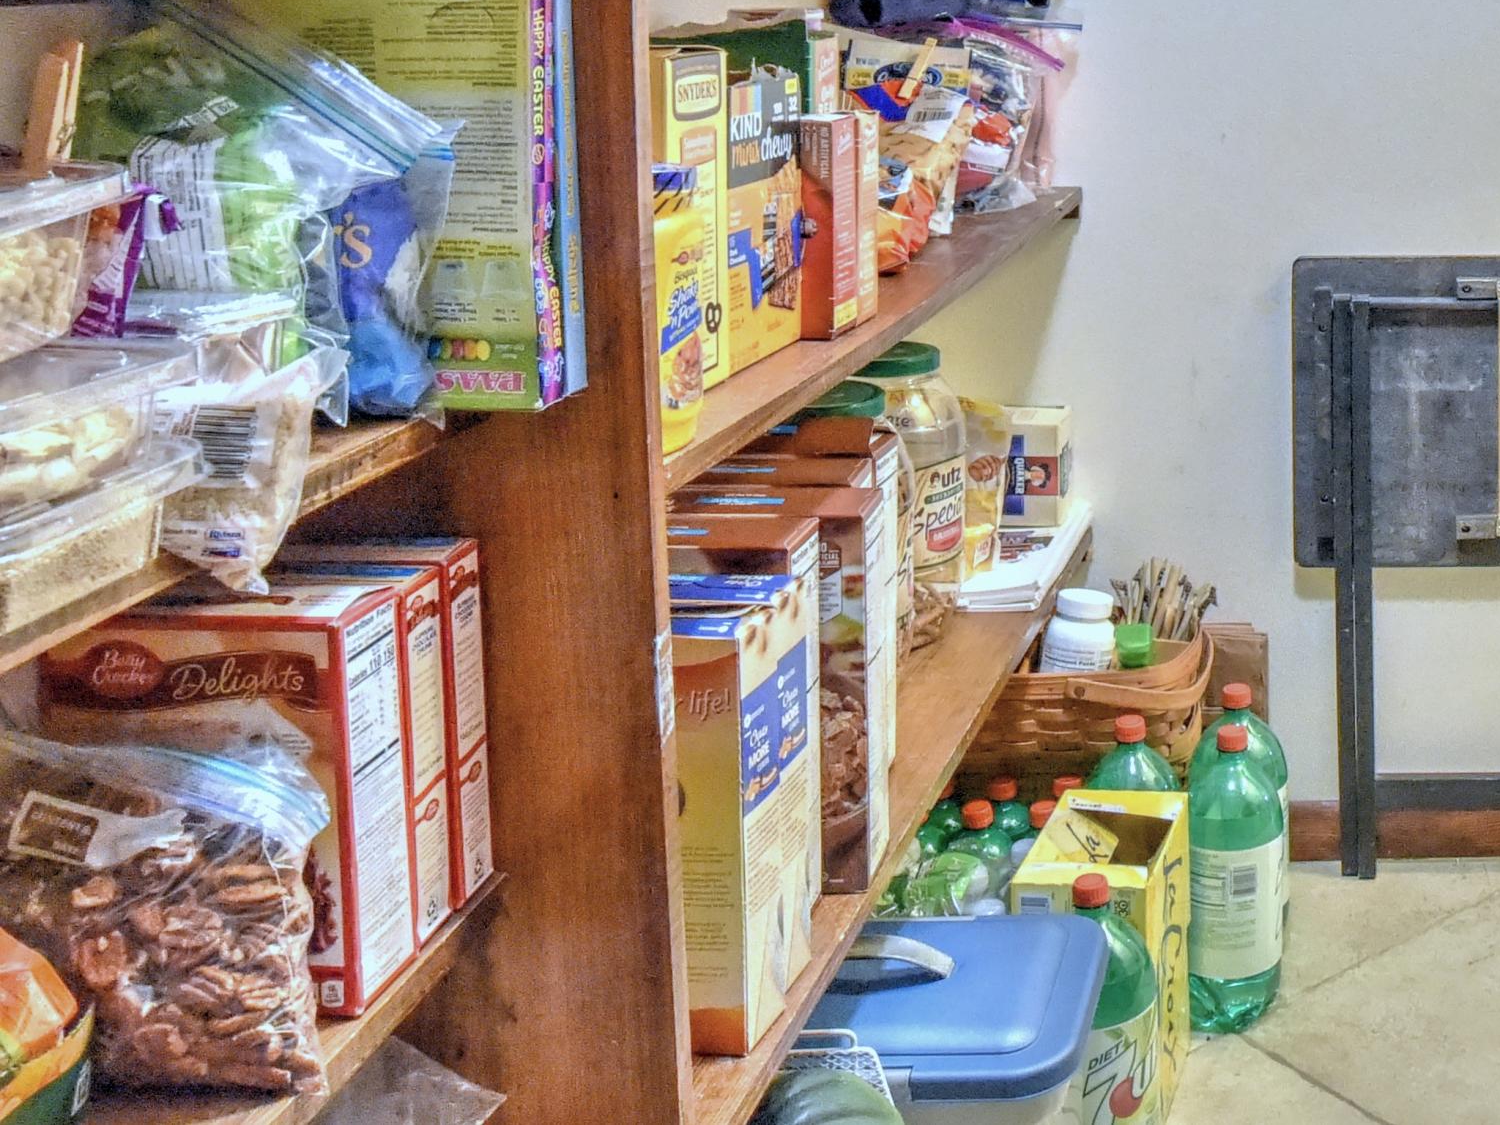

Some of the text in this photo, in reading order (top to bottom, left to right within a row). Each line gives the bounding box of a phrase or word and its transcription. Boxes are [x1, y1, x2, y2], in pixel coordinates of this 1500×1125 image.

[532, 7, 546, 137] HAPPY EASTER
[677, 77, 718, 103] SNYDER'S
[788, 95, 798, 111] 32
[729, 113, 762, 143] KIND
[760, 126, 793, 162] chewy
[550, 285, 563, 348] EASTER
[435, 370, 526, 393] PAAS
[1014, 456, 1025, 495] QUAKER
[169, 656, 305, 700] Delights
[688, 687, 732, 722] life!
[1087, 1043, 1122, 1071] DIET
